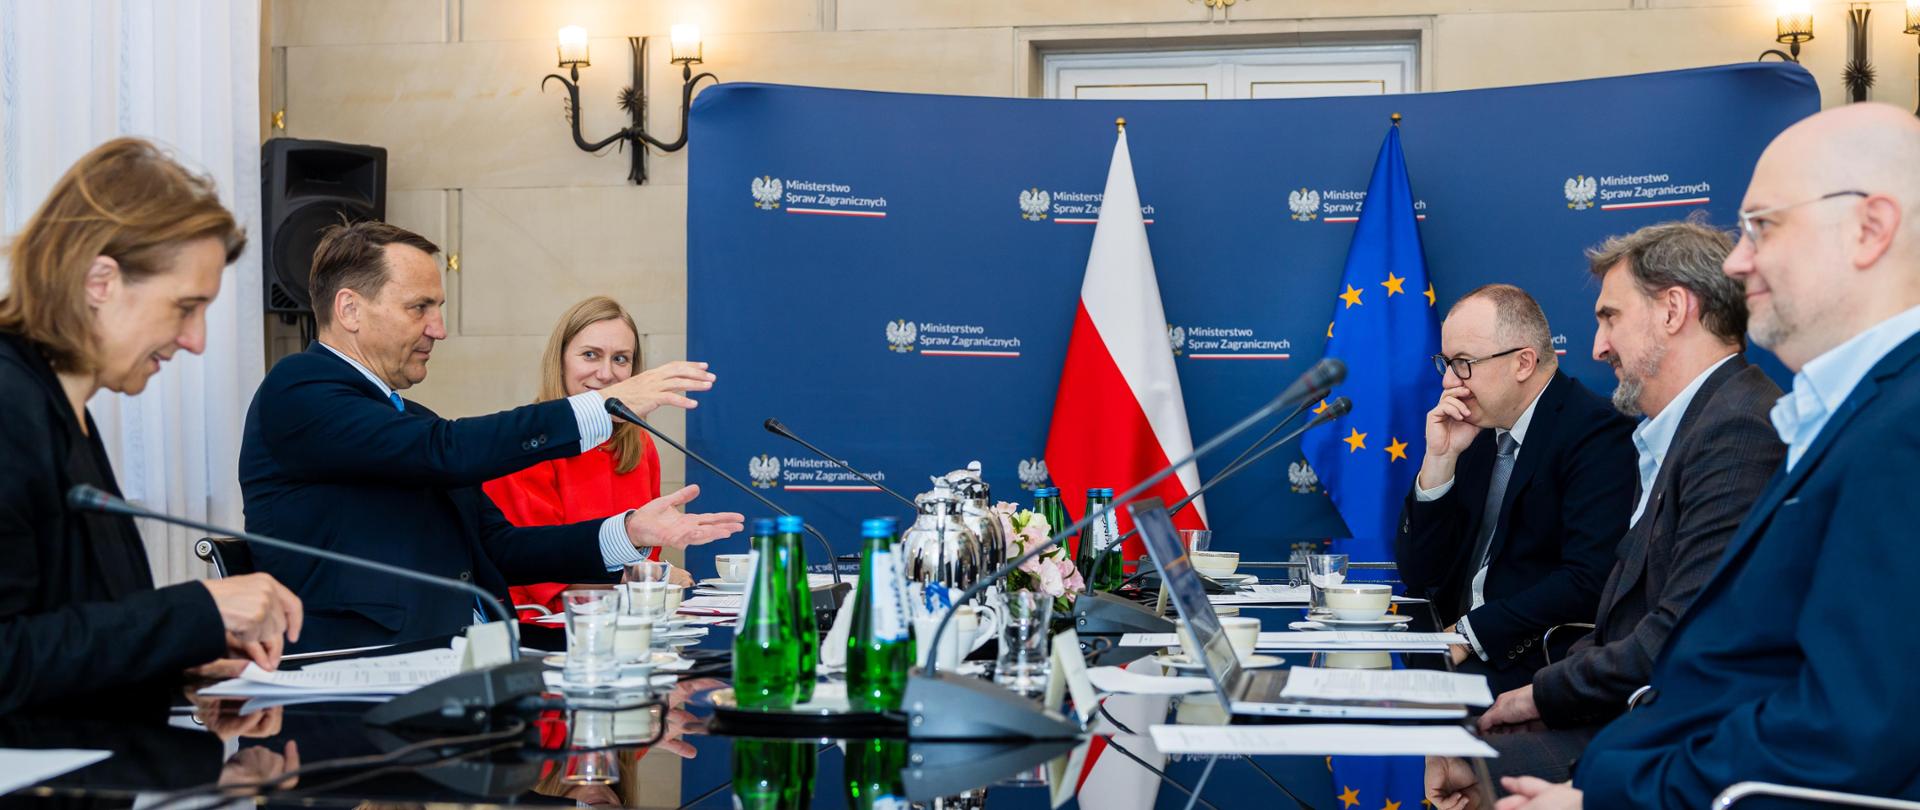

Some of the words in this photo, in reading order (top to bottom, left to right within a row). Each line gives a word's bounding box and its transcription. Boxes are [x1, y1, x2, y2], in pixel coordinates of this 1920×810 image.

[1601, 173, 1669, 186] Ministerstwo
[786, 180, 850, 193] Ministerstwo
[1601, 188, 1632, 200] Spraw
[1634, 182, 1710, 198] Zagranicznych
[786, 192, 816, 204] Spraw
[818, 194, 886, 208] Zagranicznych
[1053, 191, 1104, 202] Ministerst
[1323, 190, 1367, 200] Minister
[1053, 203, 1083, 214] Spraw
[1323, 202, 1354, 213] Spraw
[920, 322, 984, 334] Ministerstwo
[1188, 327, 1253, 337] Ministerstwo
[920, 335, 950, 346] Spraw
[951, 335, 1020, 348] Zagranicznych
[1188, 339, 1219, 350] Spraw
[1220, 339, 1290, 351] Zagranicznych
[783, 470, 814, 481] Spraw
